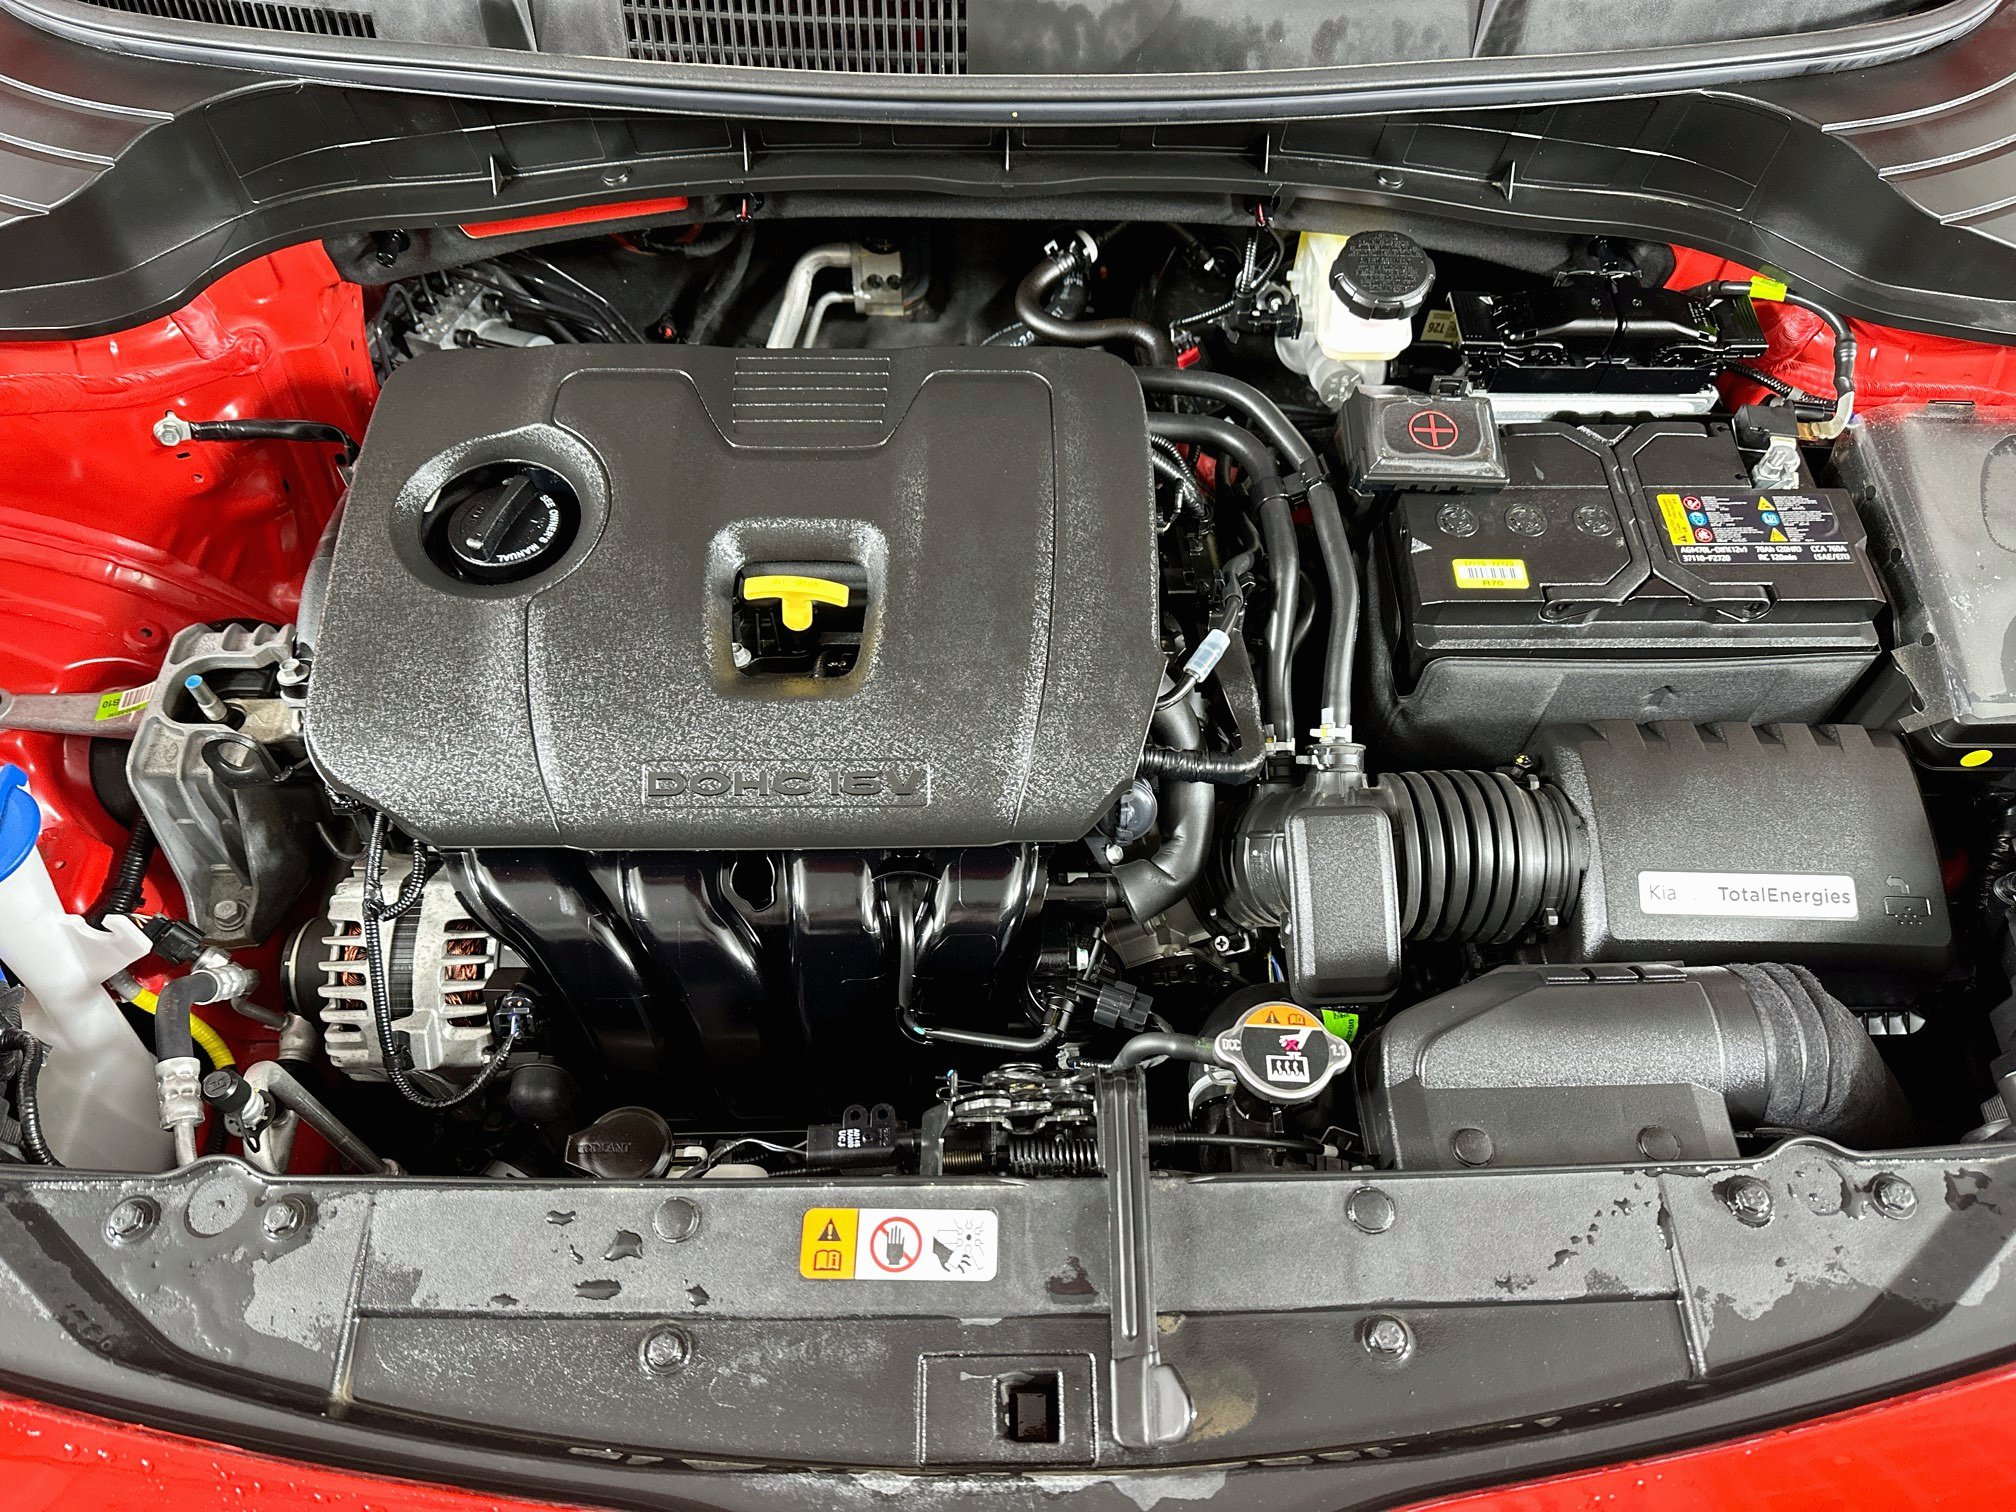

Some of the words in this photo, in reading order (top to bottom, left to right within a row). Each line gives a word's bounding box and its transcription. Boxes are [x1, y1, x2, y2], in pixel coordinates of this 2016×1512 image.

[1427, 322, 1445, 334] T26
[540, 494, 556, 509] SEE
[496, 542, 540, 563] MANUAL
[1754, 545, 1775, 553] 70Ah
[1809, 545, 1827, 553] CCA
[1757, 554, 1770, 562] RC
[1770, 554, 1798, 562] 120min
[101, 699, 121, 709] B10
[648, 771, 812, 797] DOHC
[829, 770, 924, 796] 16V
[1649, 885, 1677, 901] Kia
[1717, 886, 1851, 907] TotalEnergies
[1221, 1038, 1242, 1052] DCC
[837, 1129, 847, 1148] UCJ
[577, 1142, 632, 1153] COOLANT
